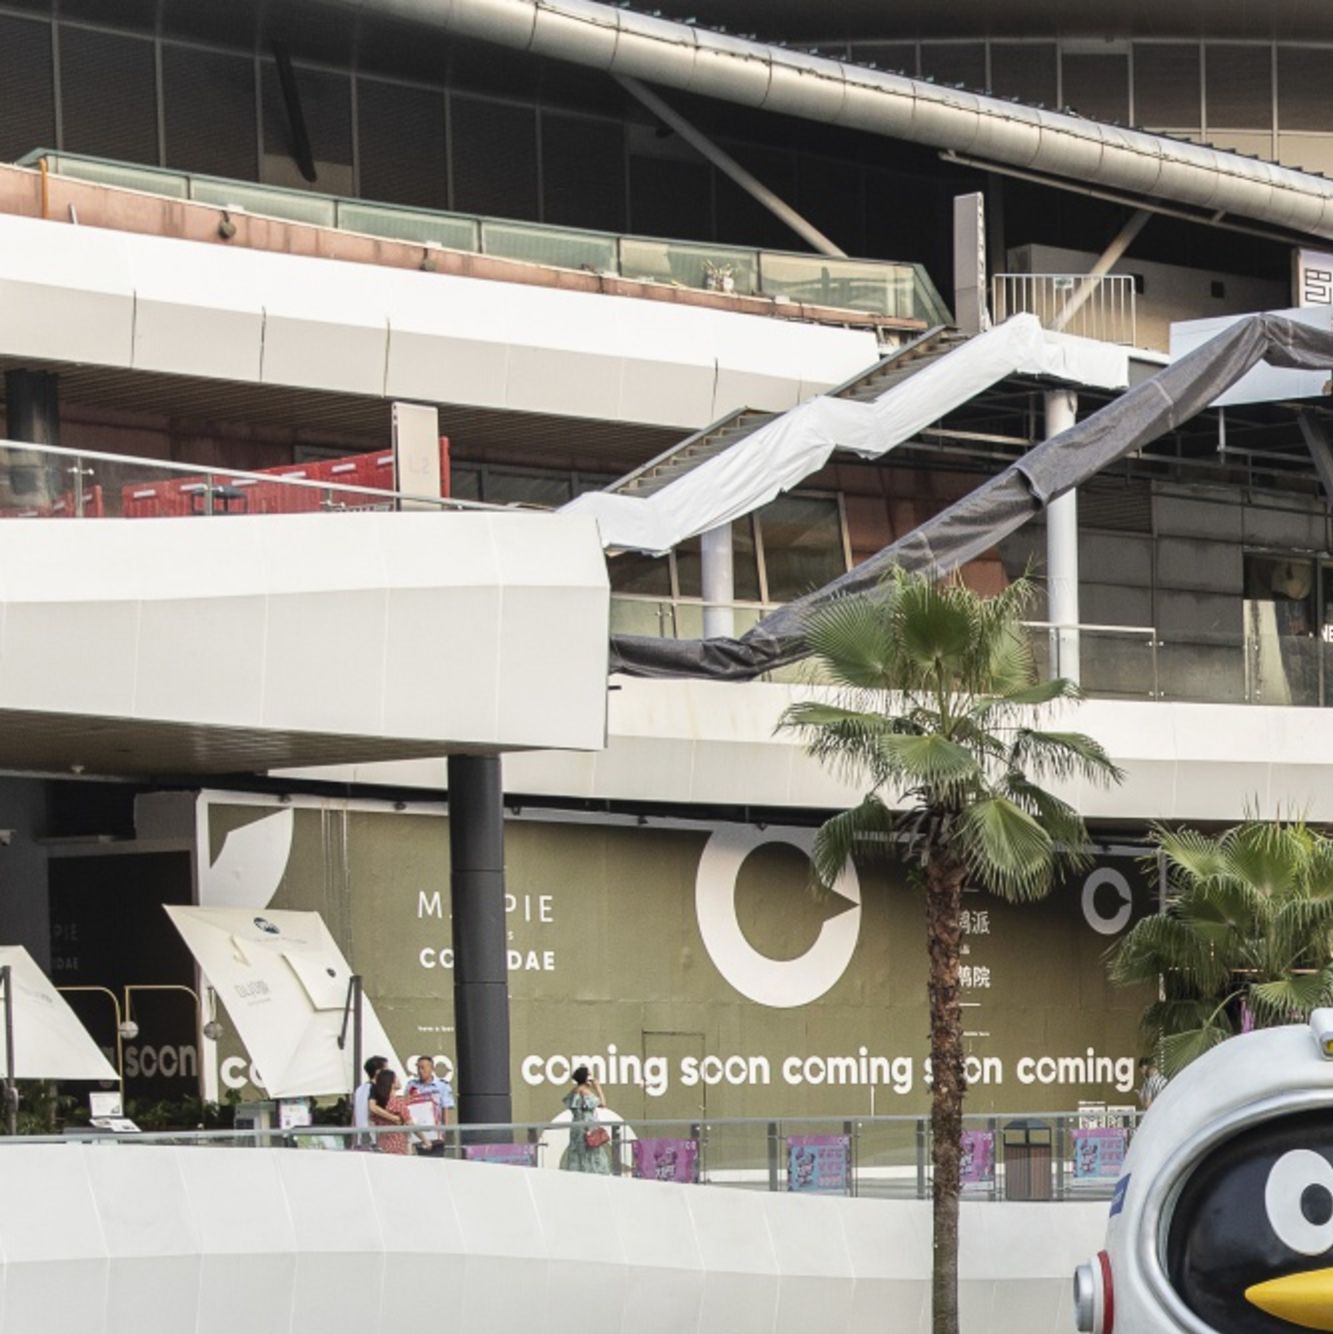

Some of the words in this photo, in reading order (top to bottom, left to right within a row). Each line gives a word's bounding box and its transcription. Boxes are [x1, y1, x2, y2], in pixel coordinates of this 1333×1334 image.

[417, 890, 554, 923] MPIE
[419, 947, 556, 971] CODAE
[521, 1044, 668, 1097] coming
[680, 1054, 771, 1087] soon
[782, 1046, 913, 1095] coming
[1016, 1046, 1135, 1093] coming
